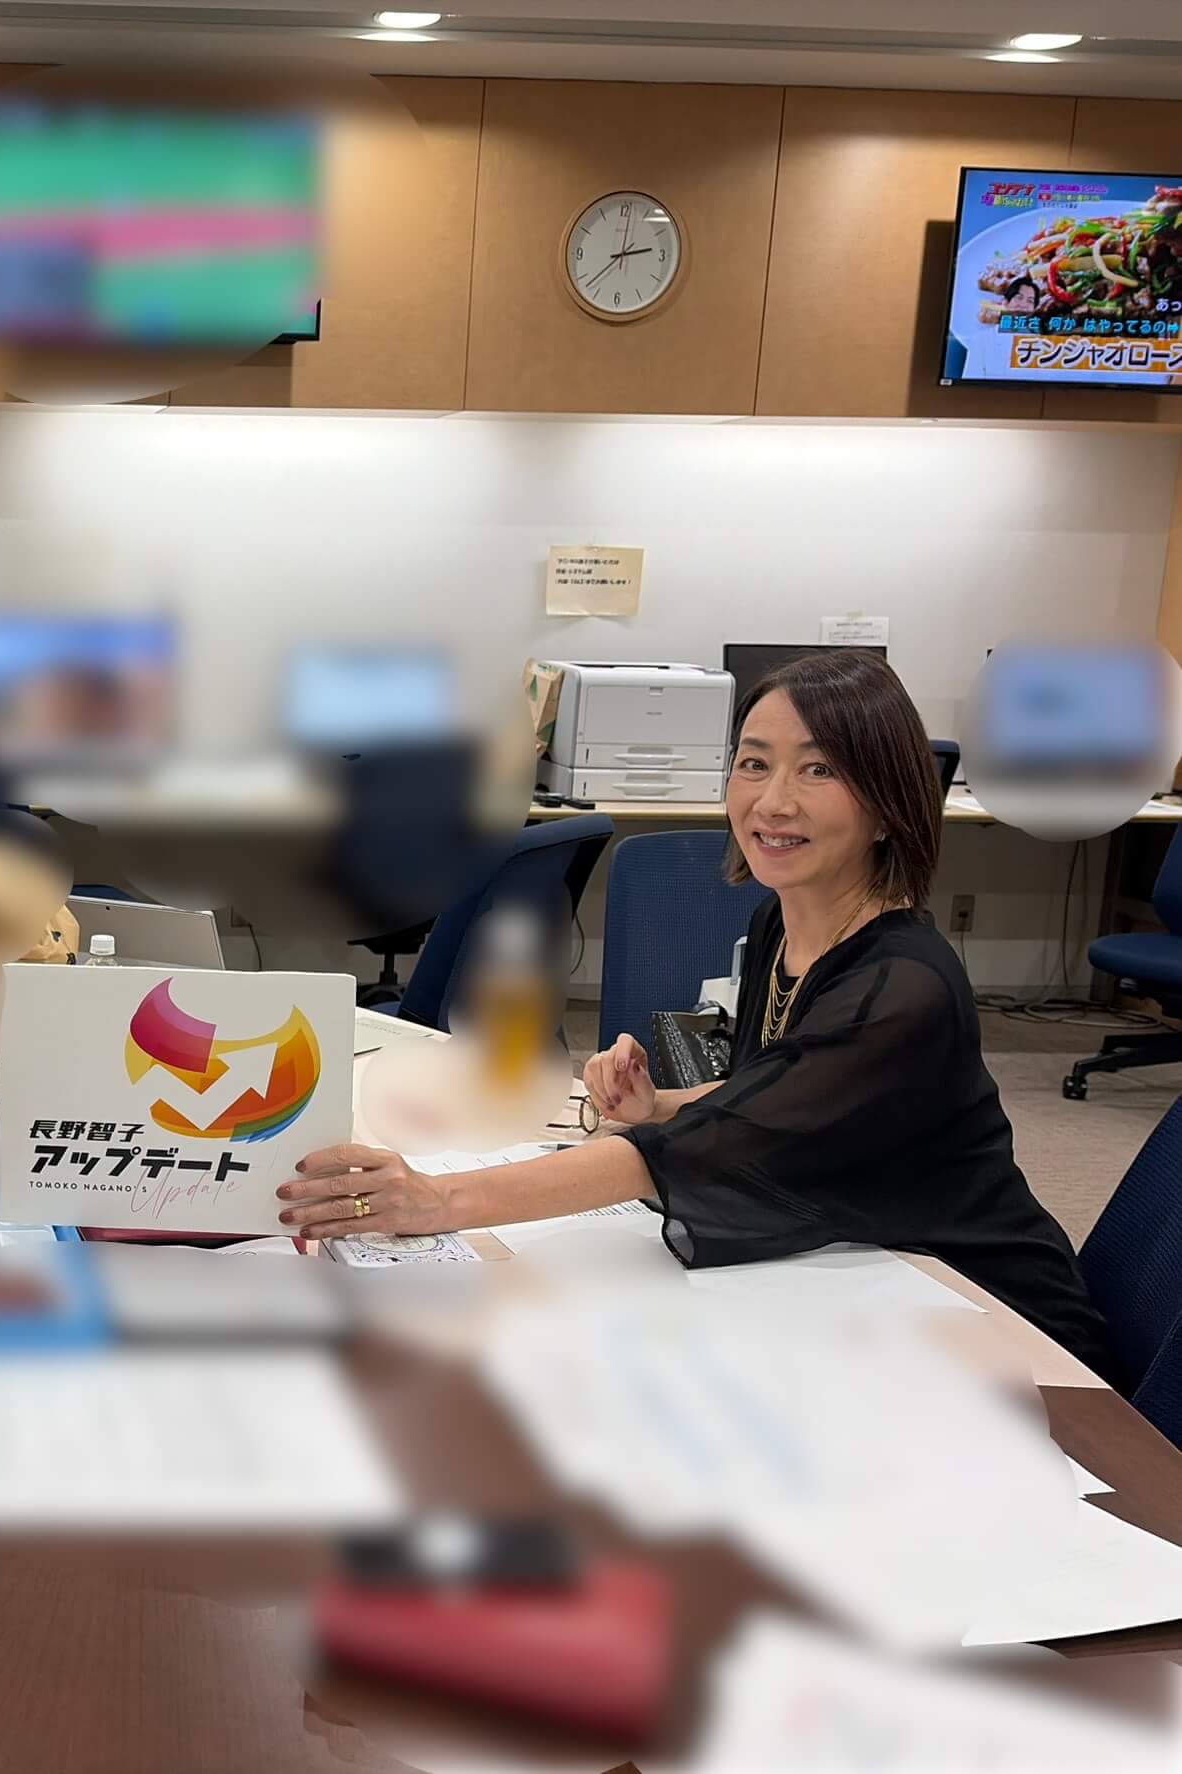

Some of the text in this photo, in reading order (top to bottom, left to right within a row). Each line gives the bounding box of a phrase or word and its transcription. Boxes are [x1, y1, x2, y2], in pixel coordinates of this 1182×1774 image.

[621, 204, 629, 217] 12
[576, 247, 584, 260] 9
[659, 249, 666, 262] 3
[614, 292, 621, 304] 6
[1000, 315, 1041, 330] 最近さ
[1049, 317, 1076, 331] 何か
[29, 1119, 146, 1142] 長野智子
[31, 1145, 250, 1182] アップデート
[29, 1181, 78, 1190] TOMOKO
[131, 1166, 242, 1219] Update
